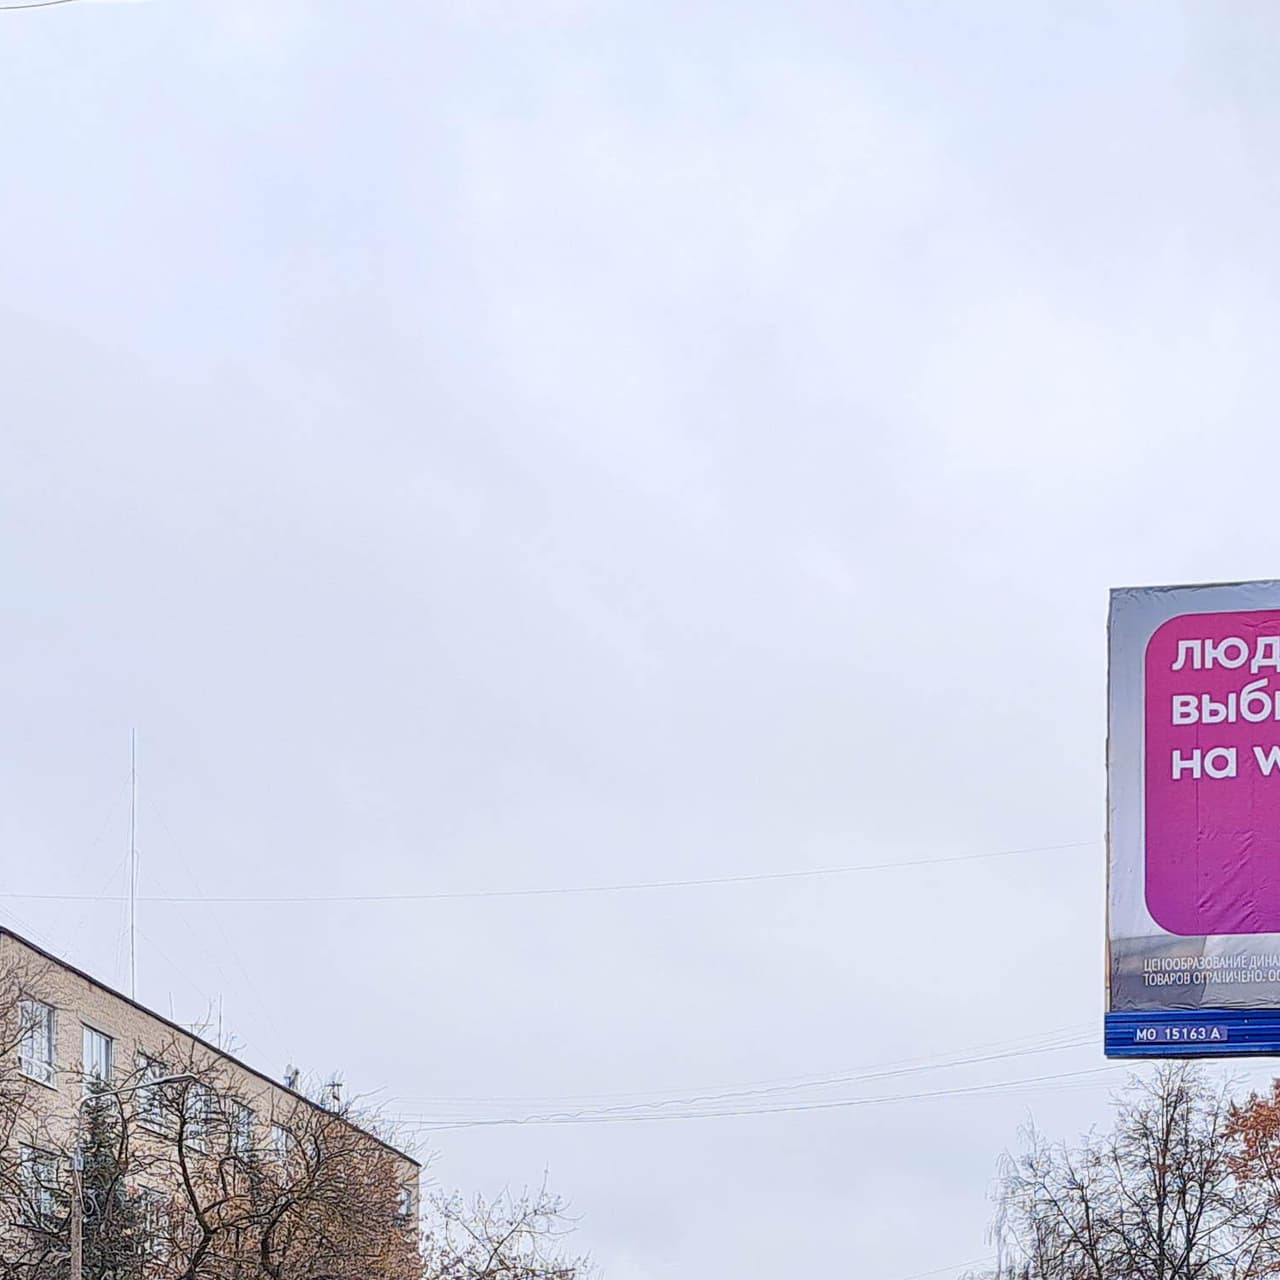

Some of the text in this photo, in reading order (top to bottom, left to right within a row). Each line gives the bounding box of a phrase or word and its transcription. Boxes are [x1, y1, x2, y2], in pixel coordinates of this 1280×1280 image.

[1171, 746, 1238, 780] на
[1144, 956, 1248, 972] ЦЕНООБРАЗОВАНИЕ
[1144, 973, 1191, 986] ТОВАРОВ
[1135, 1027, 1221, 1041] МО 15163 А
